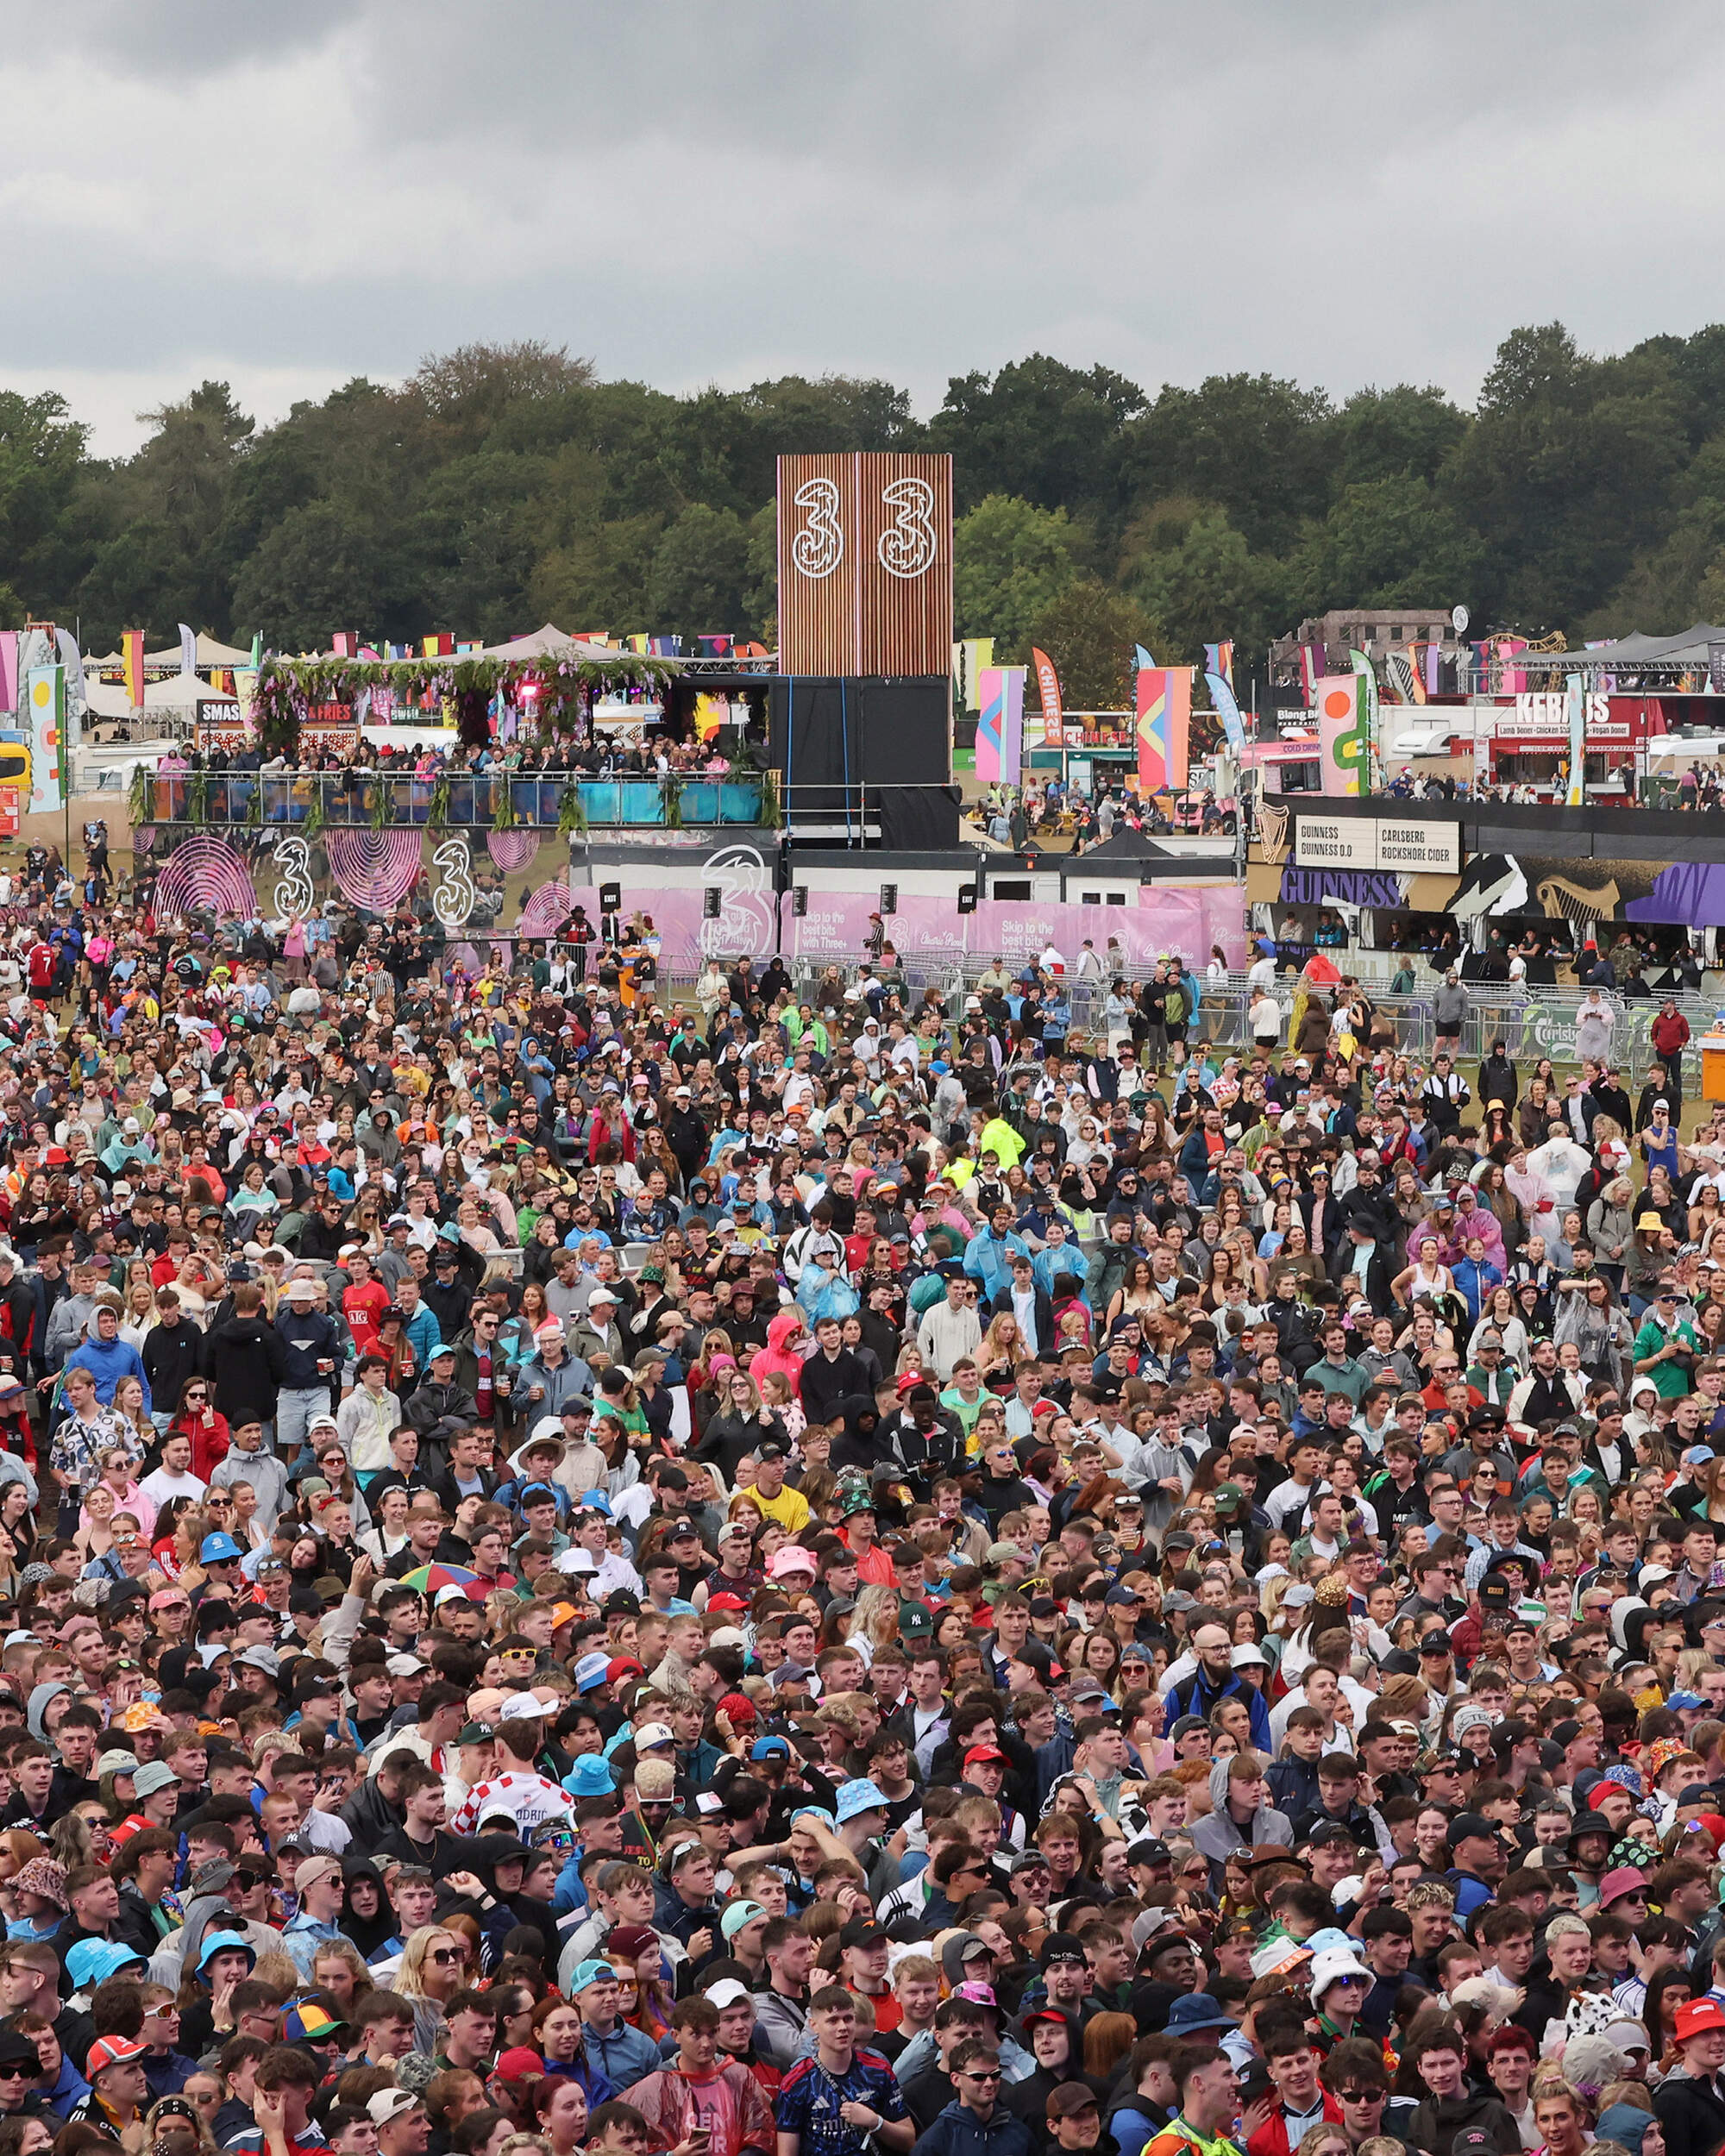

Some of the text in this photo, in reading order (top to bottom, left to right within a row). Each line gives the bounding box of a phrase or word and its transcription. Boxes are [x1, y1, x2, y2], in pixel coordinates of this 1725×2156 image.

[203, 704, 244, 720] SMAS
[317, 704, 351, 720] FRIES
[1302, 825, 1339, 839] GUINNESS
[1382, 830, 1425, 843] CARLSBERG
[1302, 843, 1352, 857] GUINNESS 0.0
[1382, 847, 1450, 862] ROCKSHORE CIDER
[1280, 868, 1402, 909] GUINNESS
[1001, 920, 1054, 935] Skip to the
[1001, 934, 1044, 947] best bits
[1535, 1018, 1581, 1047] Carlsb
[350, 1313, 367, 1324] AIG
[517, 1808, 549, 1821] ODRIĆ
